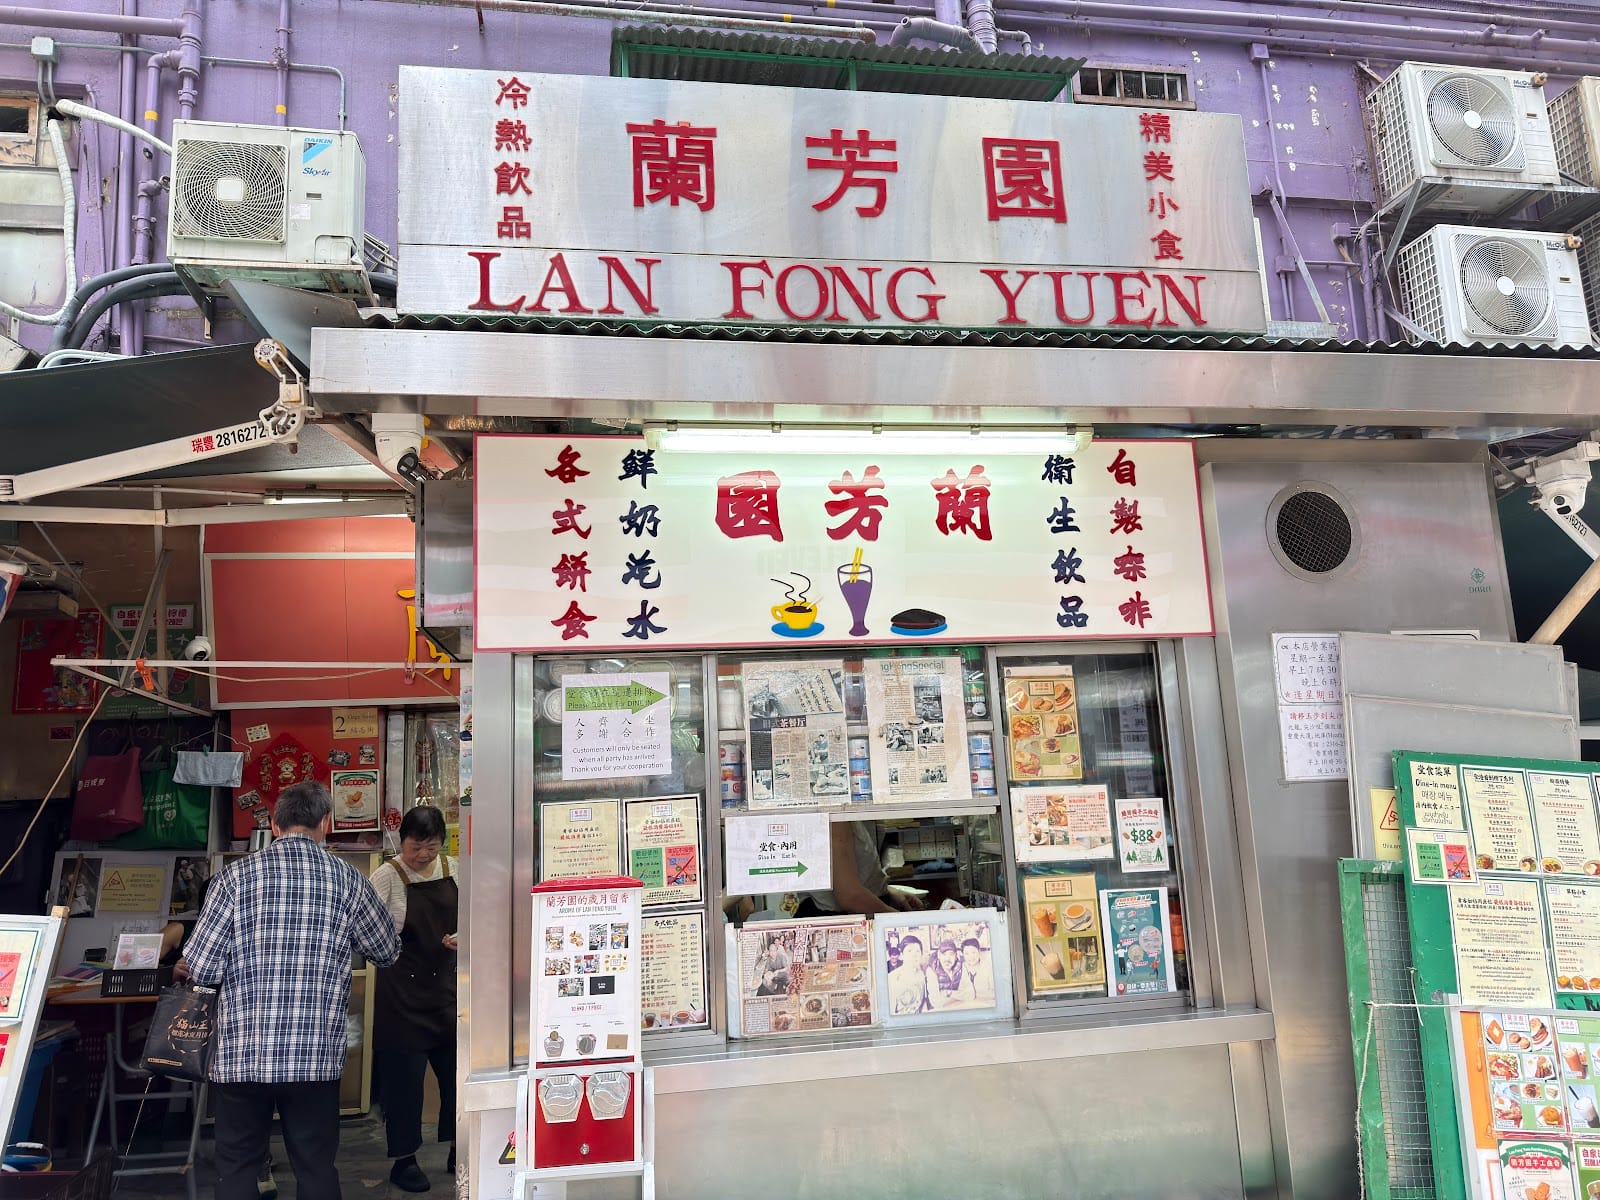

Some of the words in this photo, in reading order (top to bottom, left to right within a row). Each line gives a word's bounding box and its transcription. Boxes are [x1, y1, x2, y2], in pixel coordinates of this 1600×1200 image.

[303, 137, 333, 145] DAIKIN
[495, 76, 532, 239] 冷熱飲品
[626, 118, 1068, 224] 蘭芳園
[1139, 112, 1185, 261] 精美小食
[466, 252, 662, 315] LAN
[721, 258, 946, 323] FONG
[980, 267, 1208, 329] YUEN
[544, 444, 598, 641] 各式餅食
[617, 447, 667, 640] 鮮奶汽水
[335, 716, 346, 733] 2
[575, 727, 656, 741] 多謝合作
[572, 746, 605, 754] Customers
[617, 745, 631, 753] only
[641, 743, 661, 751] seated
[605, 756, 622, 764] party
[634, 753, 655, 761] arrived
[570, 766, 589, 774] Thank
[627, 762, 664, 771] cooperation
[1417, 764, 1452, 776] 堂食菜單
[1415, 778, 1439, 788] Dine-in
[1130, 828, 1154, 844] $88
